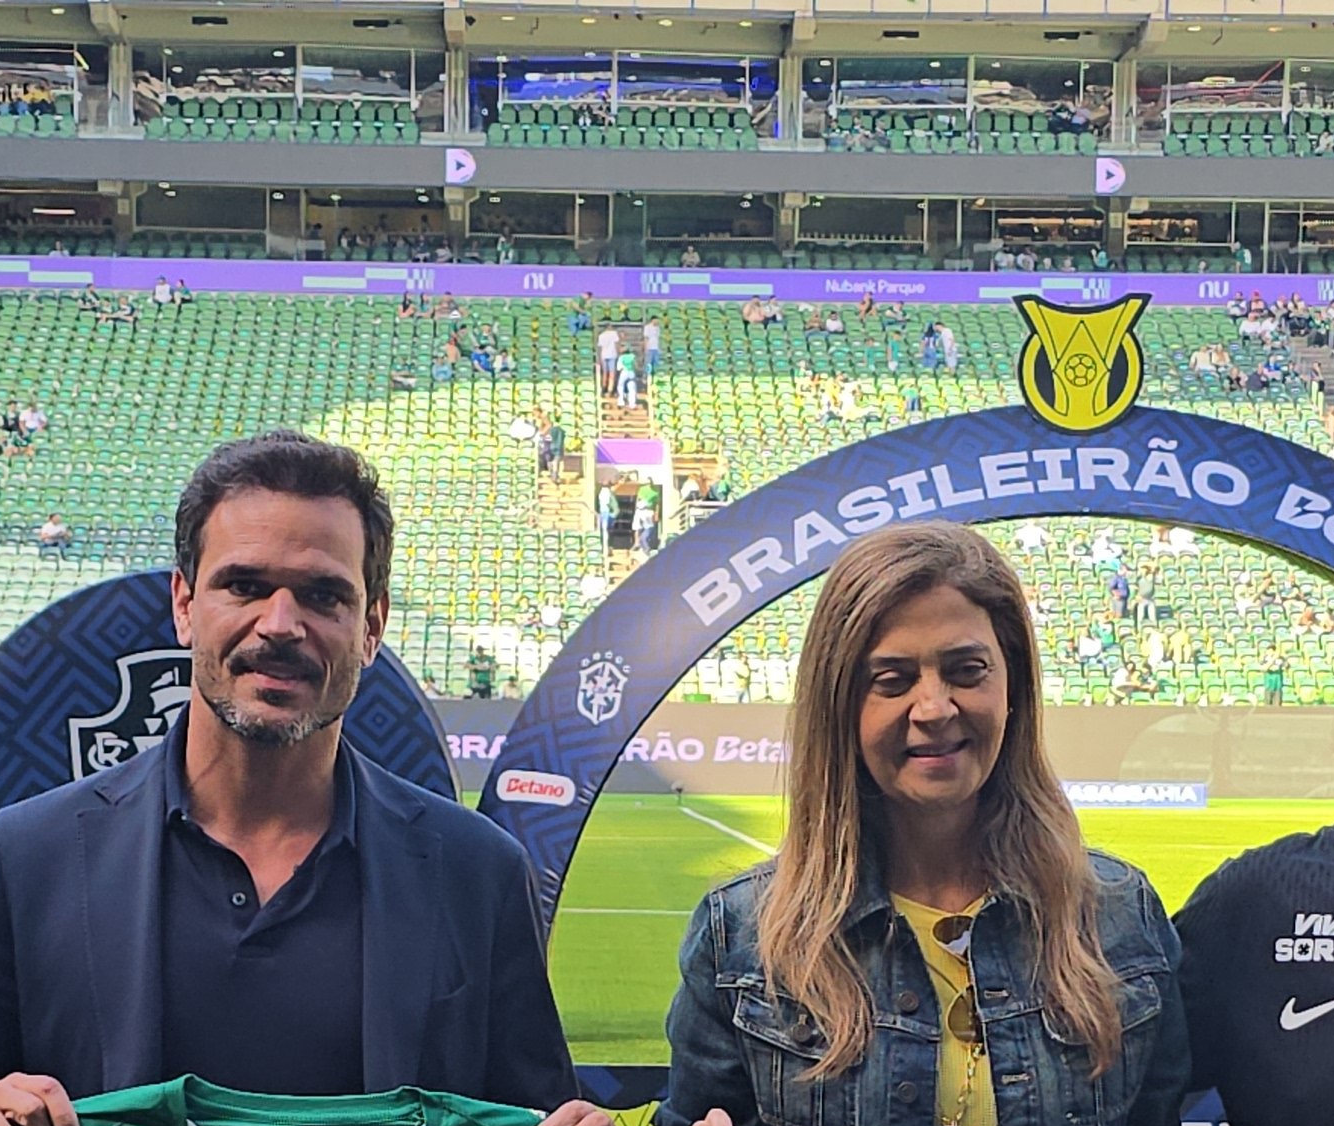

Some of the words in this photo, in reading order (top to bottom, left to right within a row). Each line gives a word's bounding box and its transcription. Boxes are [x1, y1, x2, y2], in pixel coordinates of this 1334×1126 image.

[825, 279, 876, 293] Nubank
[877, 279, 926, 296] Parque
[681, 438, 1250, 627] BRASILEIRÃO
[505, 778, 565, 798] Betano
